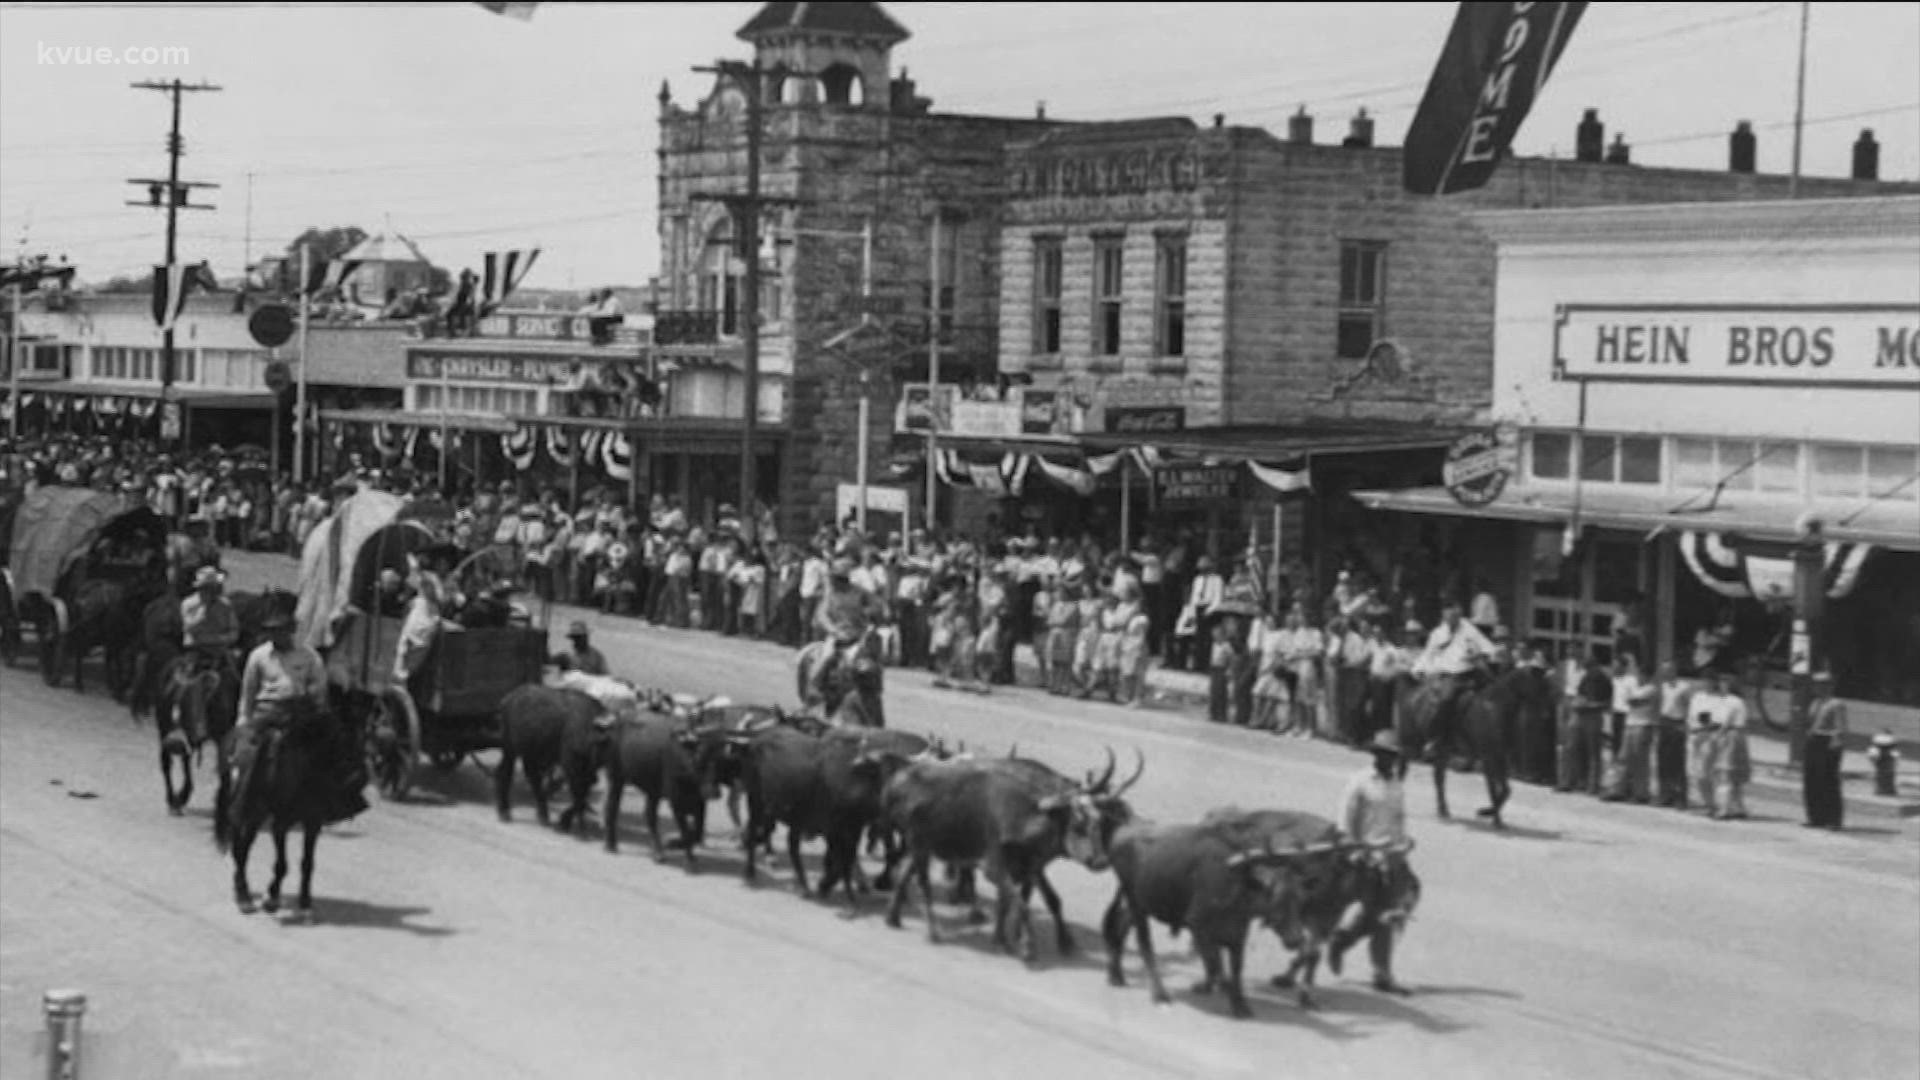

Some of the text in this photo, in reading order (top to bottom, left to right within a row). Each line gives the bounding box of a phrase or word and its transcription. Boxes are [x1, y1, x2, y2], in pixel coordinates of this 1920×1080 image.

[1595, 325, 1690, 364] HEIN
[1727, 326, 1834, 367] BROS
[440, 356, 512, 378] CHRYSLER
